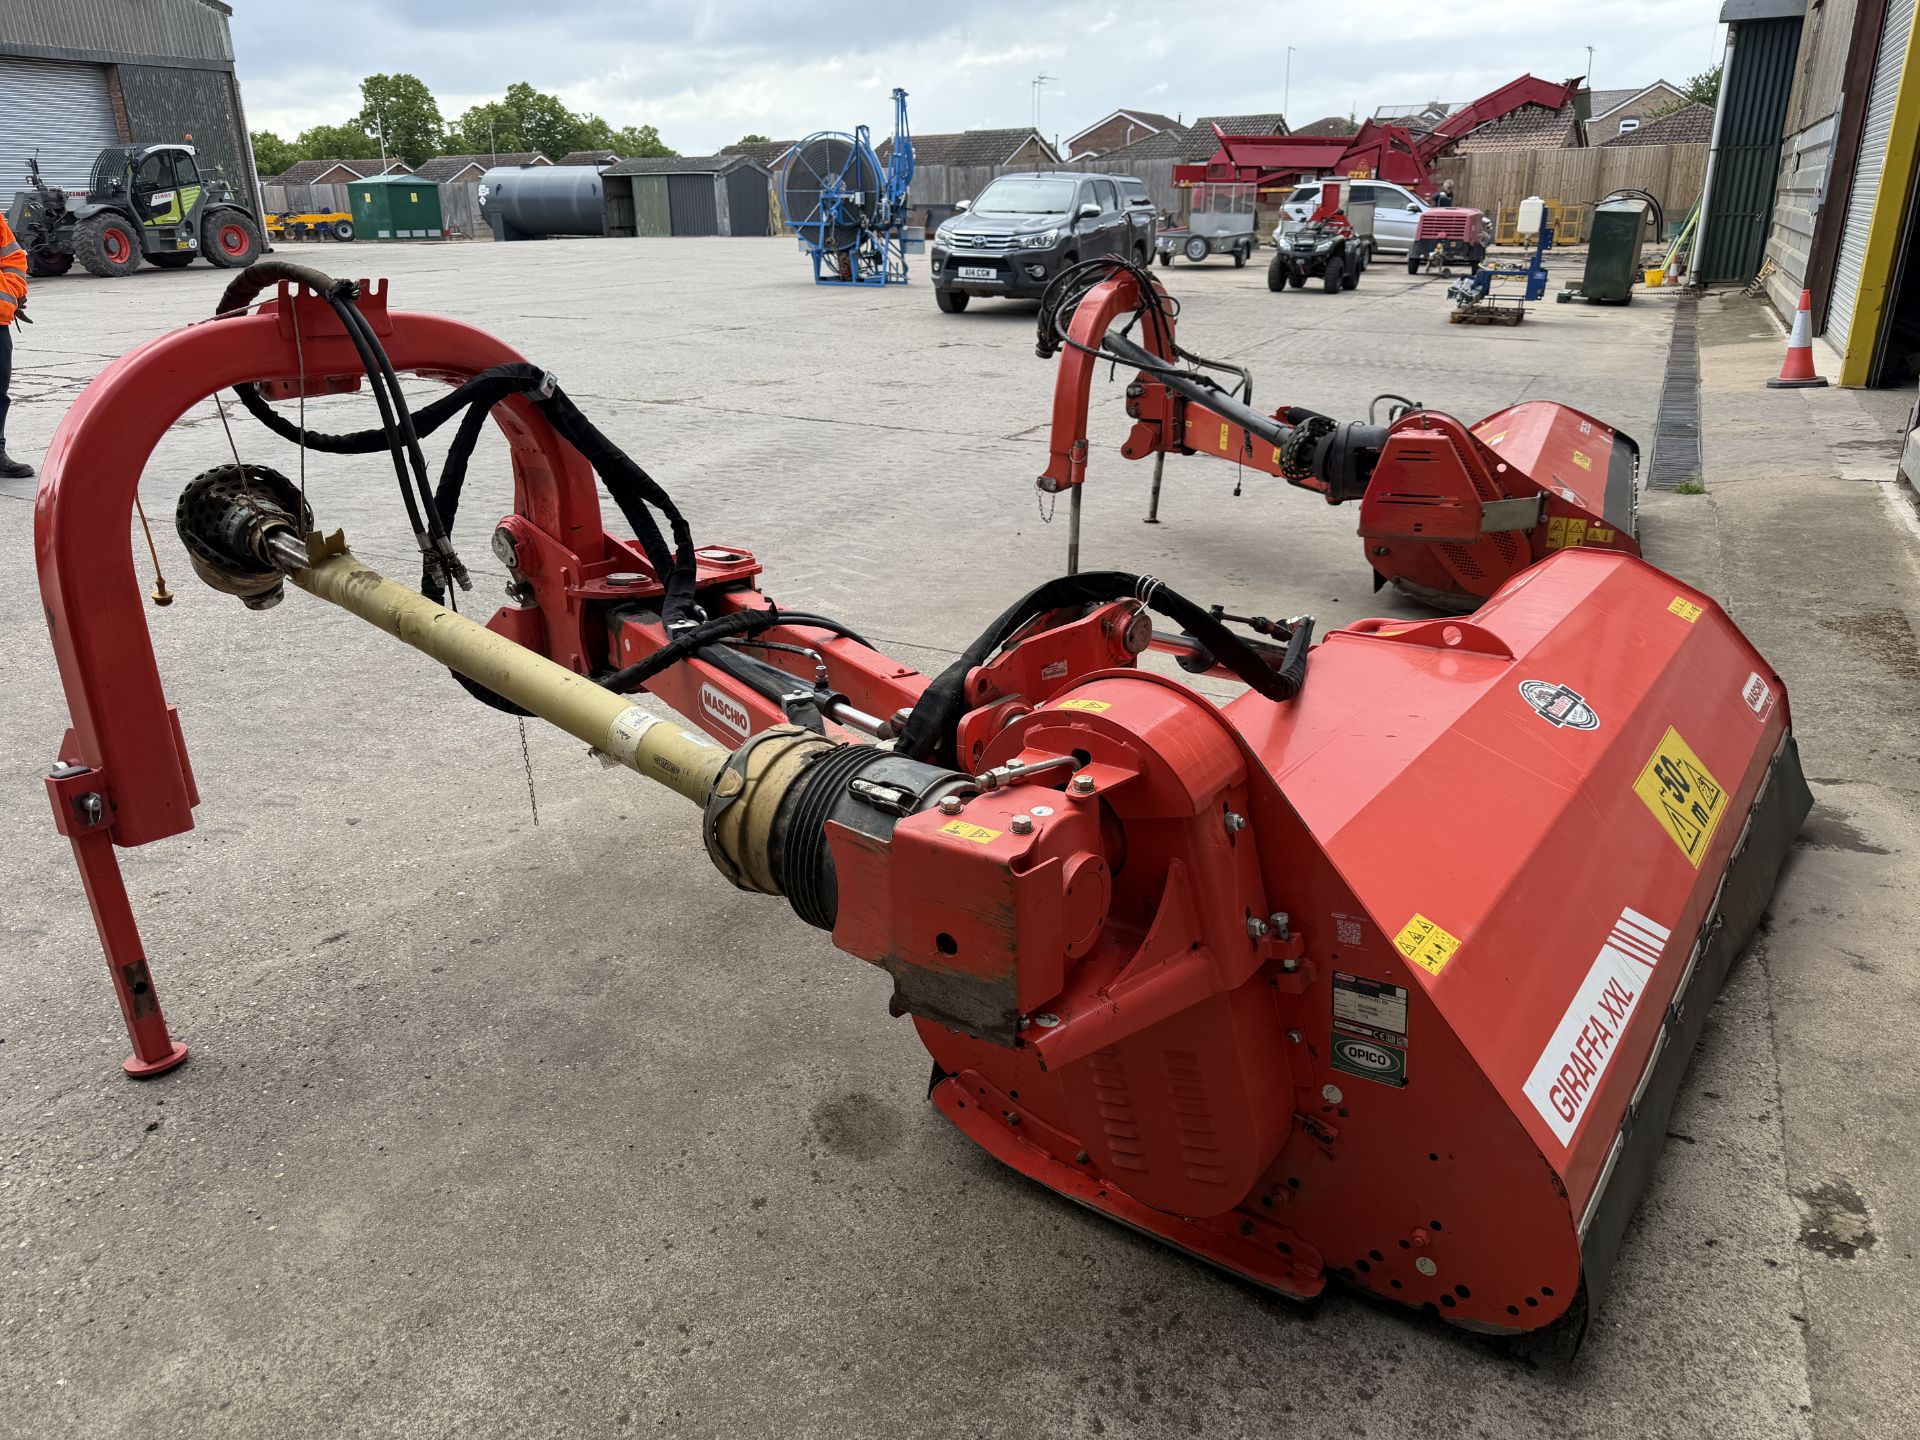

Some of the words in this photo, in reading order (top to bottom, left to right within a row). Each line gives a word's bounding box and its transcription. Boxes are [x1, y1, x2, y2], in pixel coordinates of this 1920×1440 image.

[154, 192, 172, 200] CLAAS
[703, 689, 747, 731] MASCHIO
[1653, 755, 1690, 803] 50
[1691, 801, 1709, 828] m
[1348, 1046, 1387, 1066] OPICO
[1549, 1014, 1613, 1124] GIRAFFA
[1597, 976, 1634, 1030] XXL
